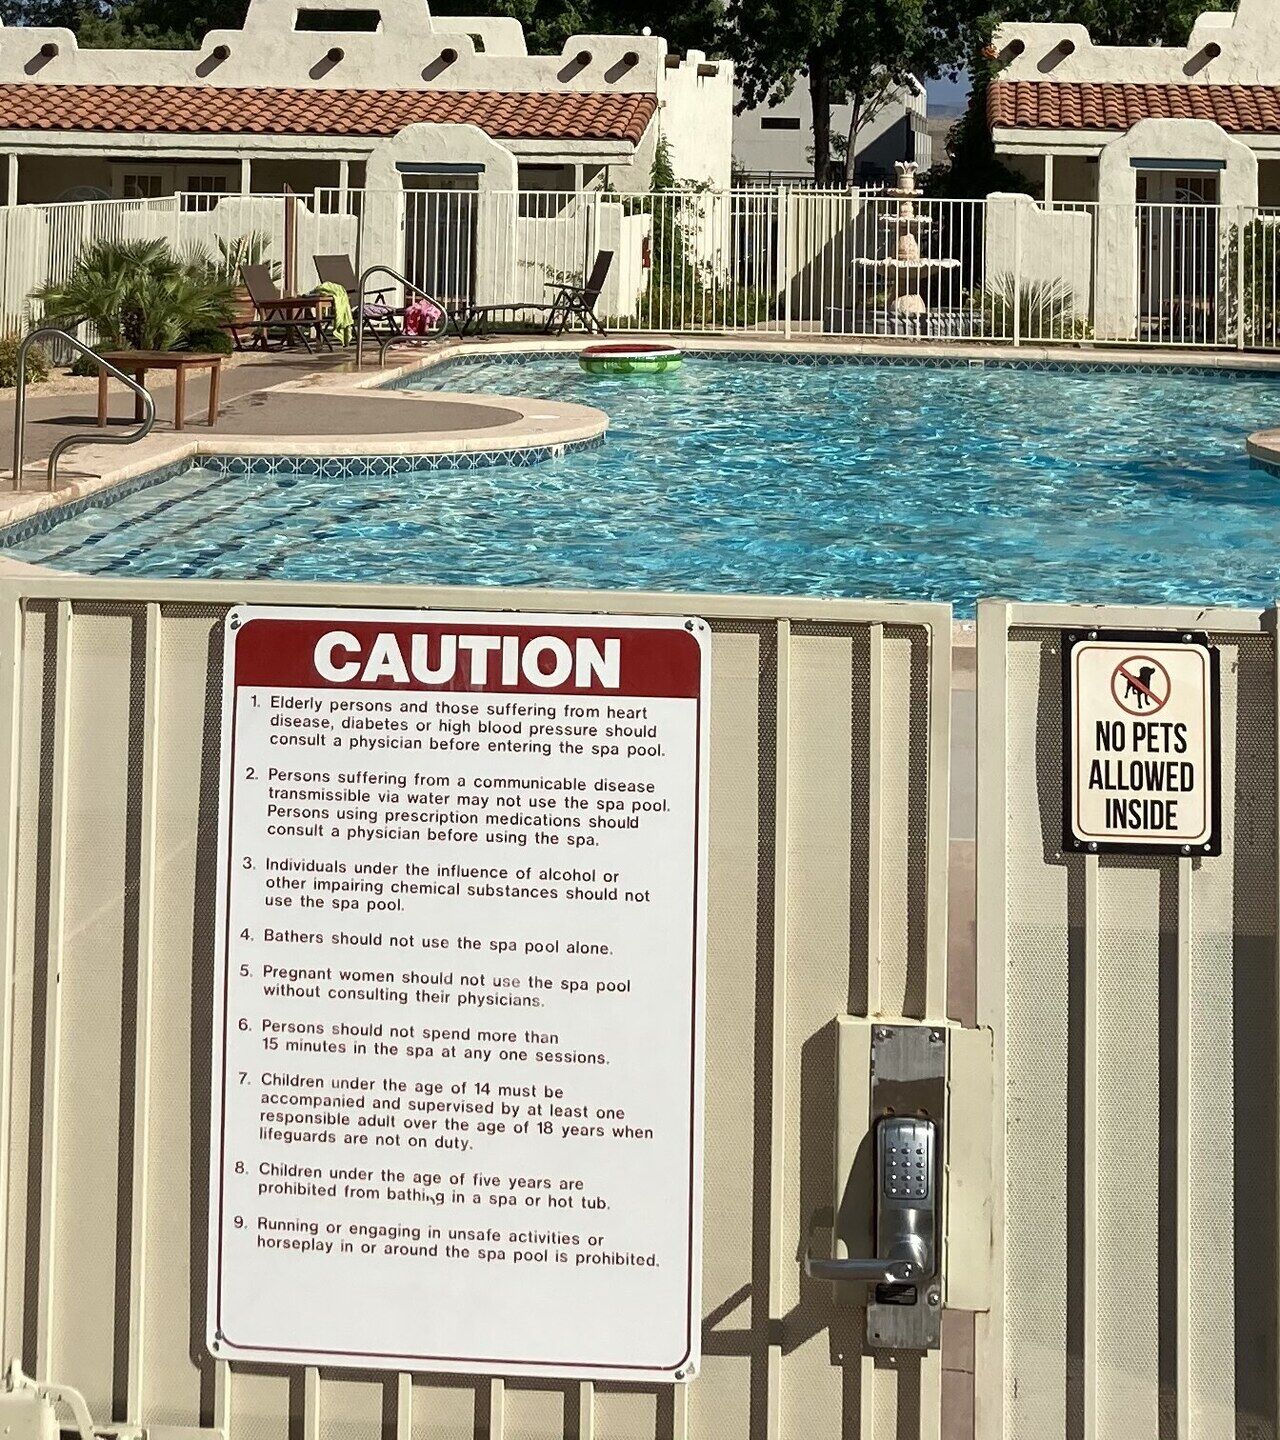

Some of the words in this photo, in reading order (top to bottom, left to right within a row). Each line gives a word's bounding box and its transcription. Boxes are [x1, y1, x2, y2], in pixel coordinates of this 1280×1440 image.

[314, 631, 620, 688] CAUTION
[251, 694, 260, 708] 1.
[270, 695, 323, 713] Elderly
[330, 700, 392, 713] persons
[399, 700, 428, 713] and
[435, 701, 479, 715] those
[486, 702, 556, 720] suffering
[564, 704, 600, 718] from
[607, 705, 648, 720] heart
[270, 713, 334, 731] disease,
[341, 716, 408, 731] diabetes
[416, 721, 432, 732] or
[439, 719, 471, 736] high
[478, 720, 522, 734] blood
[529, 725, 598, 738] pressure
[605, 724, 657, 738] should
[1096, 721, 1125, 751] NO
[1133, 722, 1186, 753] PETS
[270, 733, 327, 746] consult
[333, 737, 342, 747] a
[349, 734, 422, 751] physician
[429, 737, 480, 751] before
[488, 739, 551, 757] entering
[559, 740, 584, 755] the
[591, 745, 619, 758] spa
[627, 743, 665, 758] pool.
[245, 767, 258, 780] 2.
[268, 767, 330, 783] Persons
[337, 771, 407, 789] suffering
[414, 772, 450, 787] from
[457, 777, 466, 787] a
[473, 776, 587, 791] communicable
[594, 778, 655, 793] disease
[1089, 760, 1193, 791] ALLOWED
[267, 804, 329, 819] Persons
[337, 806, 378, 824] using
[385, 809, 478, 826] prescription
[485, 812, 581, 828] medications
[588, 815, 639, 829] should
[1106, 799, 1177, 830] INSIDE
[267, 823, 324, 837] consult
[331, 827, 340, 837] a
[347, 825, 420, 841] physician
[427, 827, 478, 842] before
[486, 830, 527, 847] using
[534, 831, 559, 845] the
[567, 835, 599, 848] spa.
[242, 856, 256, 870] 3.
[266, 857, 347, 873] Individuals
[354, 861, 399, 875] under
[405, 863, 430, 876] the
[437, 863, 508, 879] influence
[515, 867, 532, 880] of
[539, 867, 596, 882] alcohol
[603, 872, 619, 883] or
[266, 876, 307, 890] other
[313, 876, 384, 896] impairing
[391, 880, 460, 896] chemical
[467, 883, 558, 899] substances
[566, 886, 618, 901] should
[625, 890, 650, 903] not
[265, 896, 292, 907] use
[300, 894, 324, 908] the
[332, 898, 359, 912] spa
[367, 898, 404, 913] pool.
[240, 928, 254, 942] 4.
[264, 928, 324, 944] Bathers
[332, 931, 382, 946] should
[389, 935, 414, 947] not
[422, 938, 449, 949] use
[457, 936, 482, 950] the
[489, 940, 517, 954] spa
[525, 940, 559, 955] pool
[566, 941, 613, 955] alone.
[238, 1018, 252, 1031] 6.
[262, 1019, 324, 1035] Persons
[332, 1022, 383, 1037] should
[390, 1026, 415, 1038] not
[422, 1027, 470, 1042] spend
[477, 1031, 517, 1043] more
[524, 1030, 559, 1044] than
[239, 1071, 251, 1085] 7.
[261, 1072, 324, 1088] Children
[331, 1077, 376, 1091] under
[383, 1078, 407, 1092] the
[415, 1082, 443, 1096] age
[451, 1081, 467, 1095] of
[474, 1082, 491, 1096] 14
[498, 1084, 536, 1098] must
[544, 1085, 564, 1099] be
[261, 1094, 365, 1109] accompanied
[372, 1097, 401, 1110] and
[408, 1099, 494, 1115] supervised
[501, 1101, 520, 1118] by
[527, 1103, 543, 1117] at
[550, 1103, 588, 1119] least
[596, 1109, 625, 1120] one
[259, 1126, 336, 1144] lifeguards
[344, 1134, 368, 1145] are
[376, 1134, 400, 1146] not
[408, 1136, 427, 1148] on
[434, 1135, 473, 1152] duty.
[235, 1161, 249, 1175] 8.
[259, 1162, 322, 1179] Children
[329, 1167, 374, 1181] under
[381, 1169, 405, 1182] the
[413, 1173, 441, 1187] age
[449, 1172, 465, 1186] of
[473, 1172, 501, 1187] five
[508, 1177, 551, 1190] years
[559, 1179, 584, 1191] are
[234, 1215, 248, 1229] 9.
[258, 1216, 319, 1236] Running
[326, 1223, 342, 1234] or
[349, 1223, 421, 1241] engaging
[428, 1225, 441, 1239] in
[448, 1228, 501, 1242] unsafe
[509, 1230, 580, 1245] activities
[588, 1236, 604, 1246] or
[257, 1234, 333, 1254] horseplay
[340, 1239, 353, 1253] in
[361, 1243, 377, 1254] or
[384, 1244, 438, 1257] around
[445, 1245, 470, 1258] the
[478, 1249, 506, 1263] spa
[513, 1249, 548, 1264] pool
[555, 1249, 568, 1263] is
[576, 1251, 659, 1267] prohibited.
